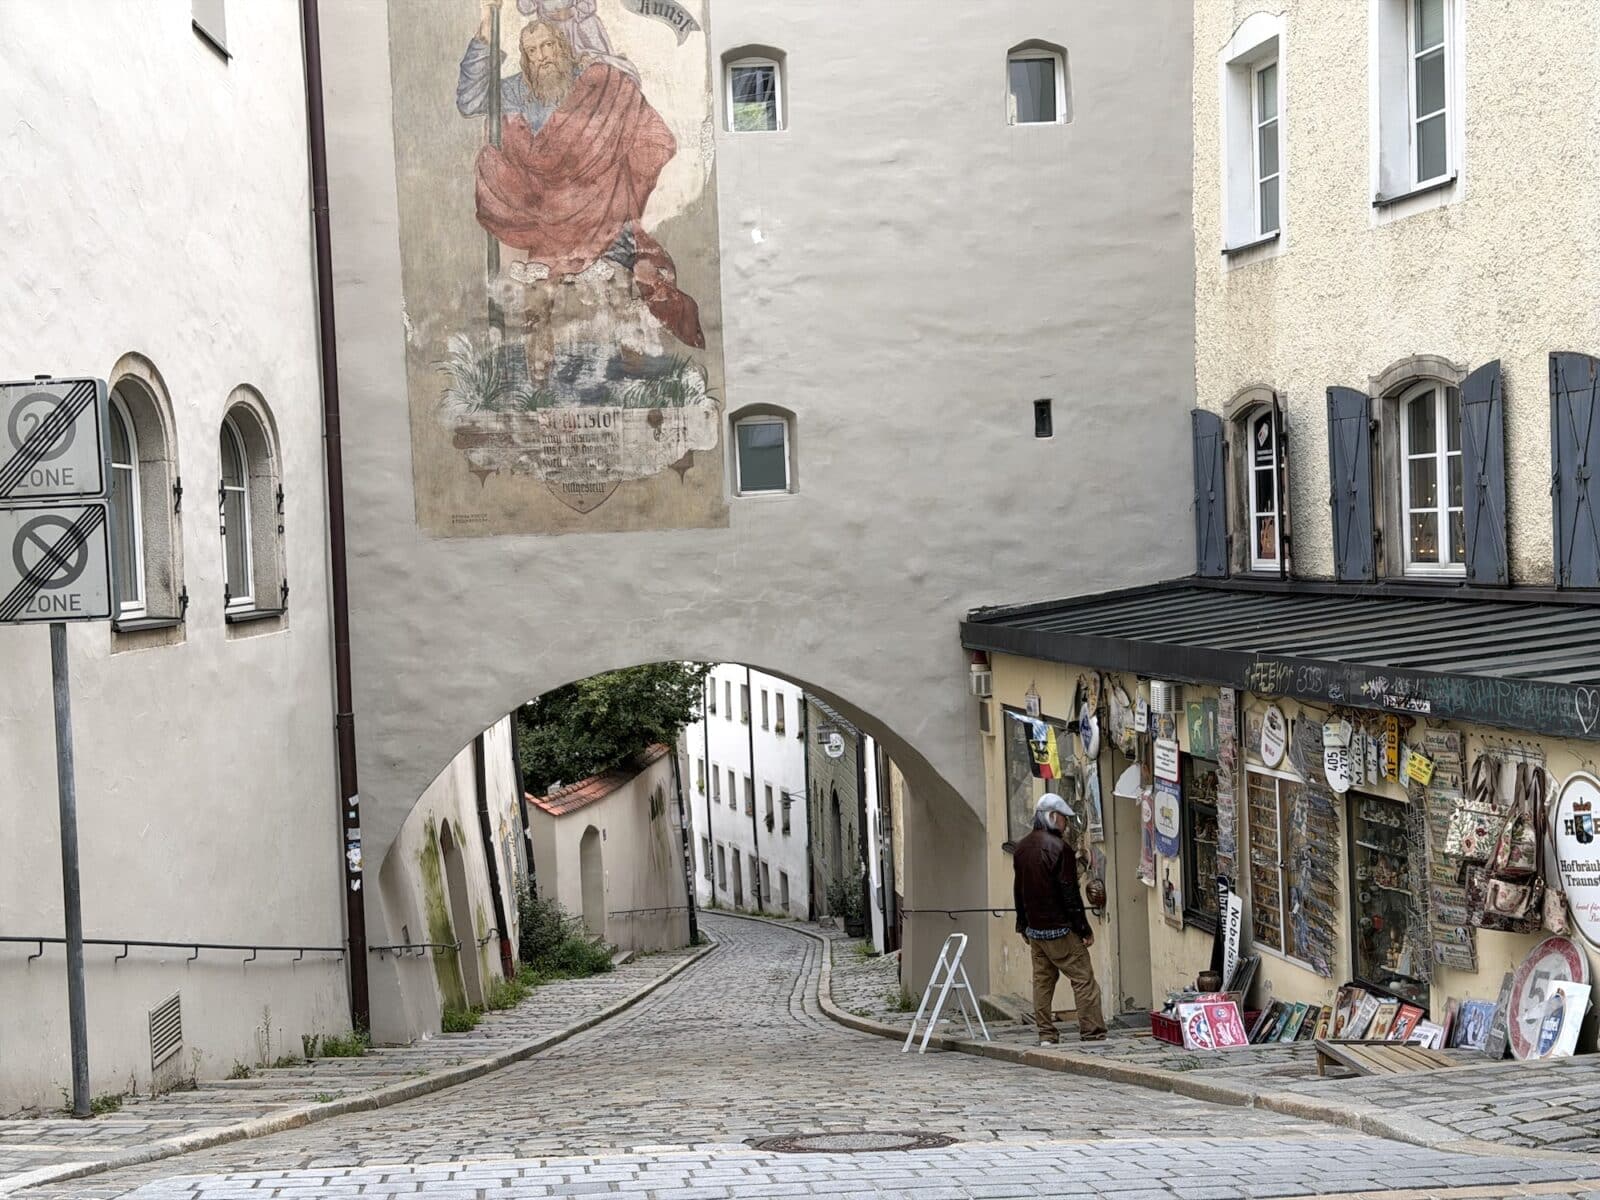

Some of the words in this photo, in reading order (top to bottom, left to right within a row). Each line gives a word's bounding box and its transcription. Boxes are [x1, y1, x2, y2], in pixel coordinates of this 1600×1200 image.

[17, 467, 75, 488] ZONE
[25, 593, 82, 613] ZONE
[1327, 751, 1339, 772] 405
